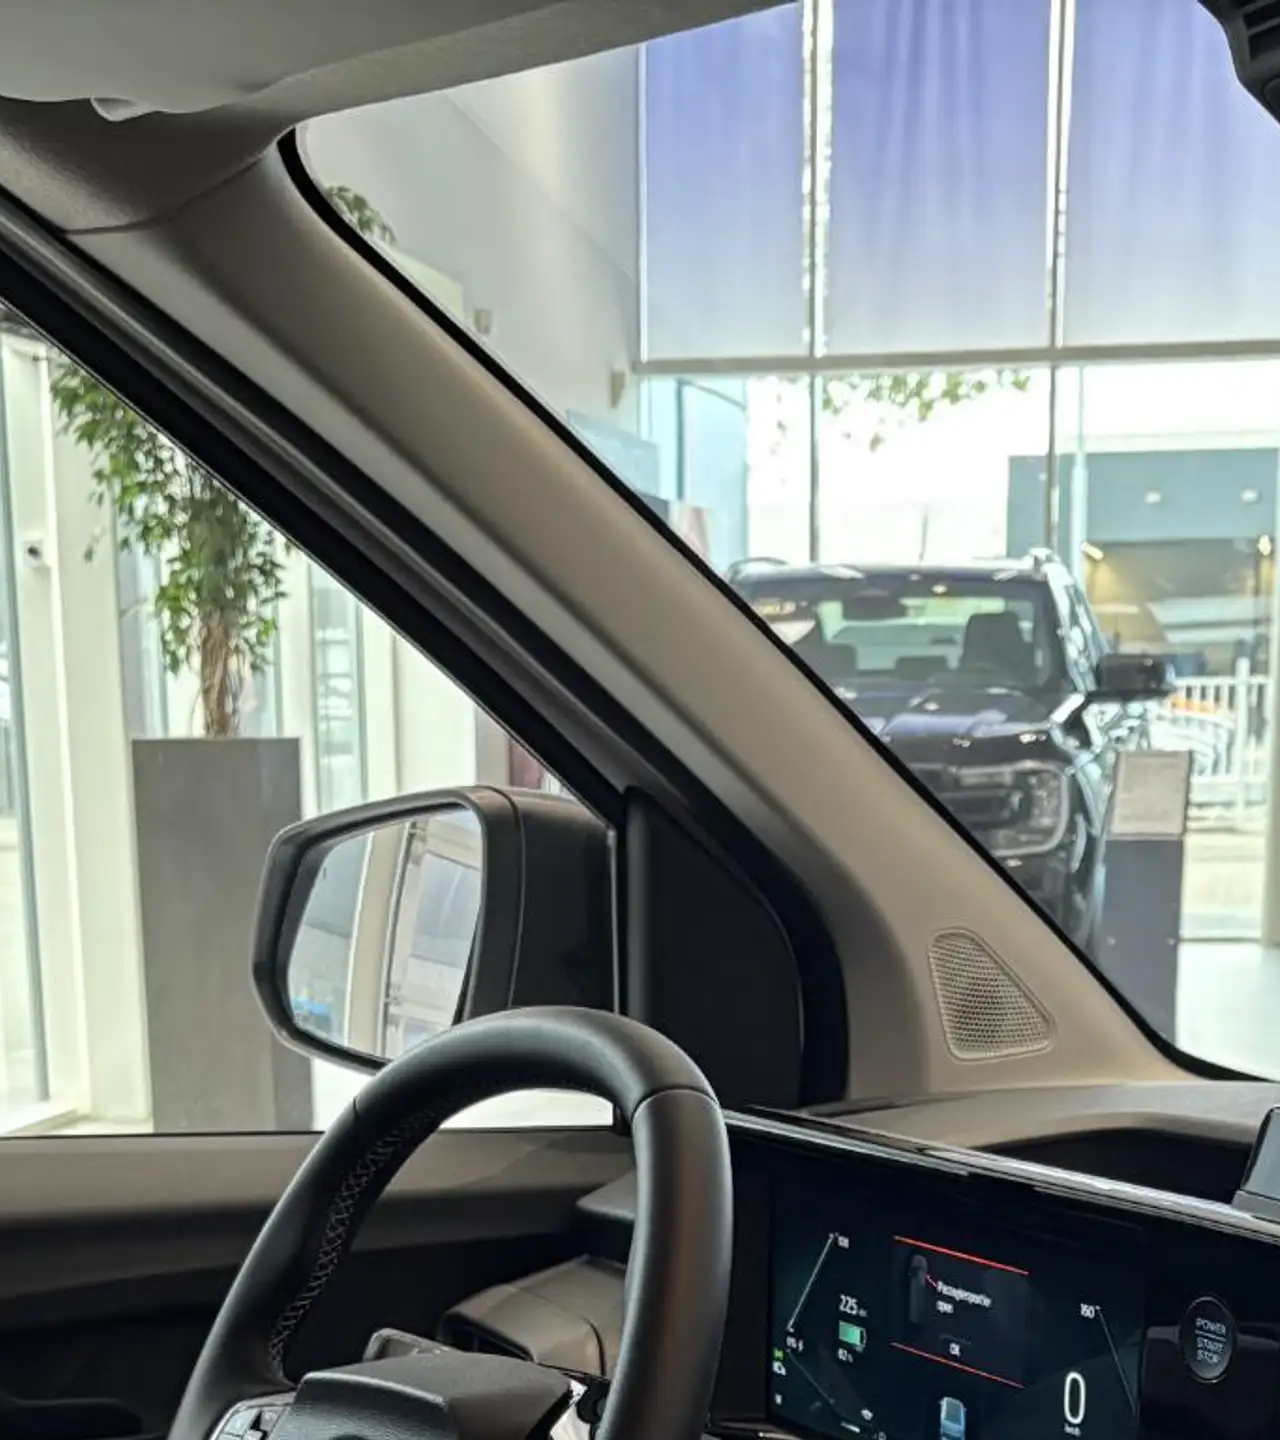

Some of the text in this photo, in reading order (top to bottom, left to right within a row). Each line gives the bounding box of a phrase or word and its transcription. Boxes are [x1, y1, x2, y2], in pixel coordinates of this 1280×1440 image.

[839, 1294, 860, 1316] 225
[1195, 1317, 1226, 1335] POWER
[1196, 1336, 1224, 1353] START
[1196, 1349, 1221, 1364] STOP
[1063, 1371, 1086, 1425] 0
